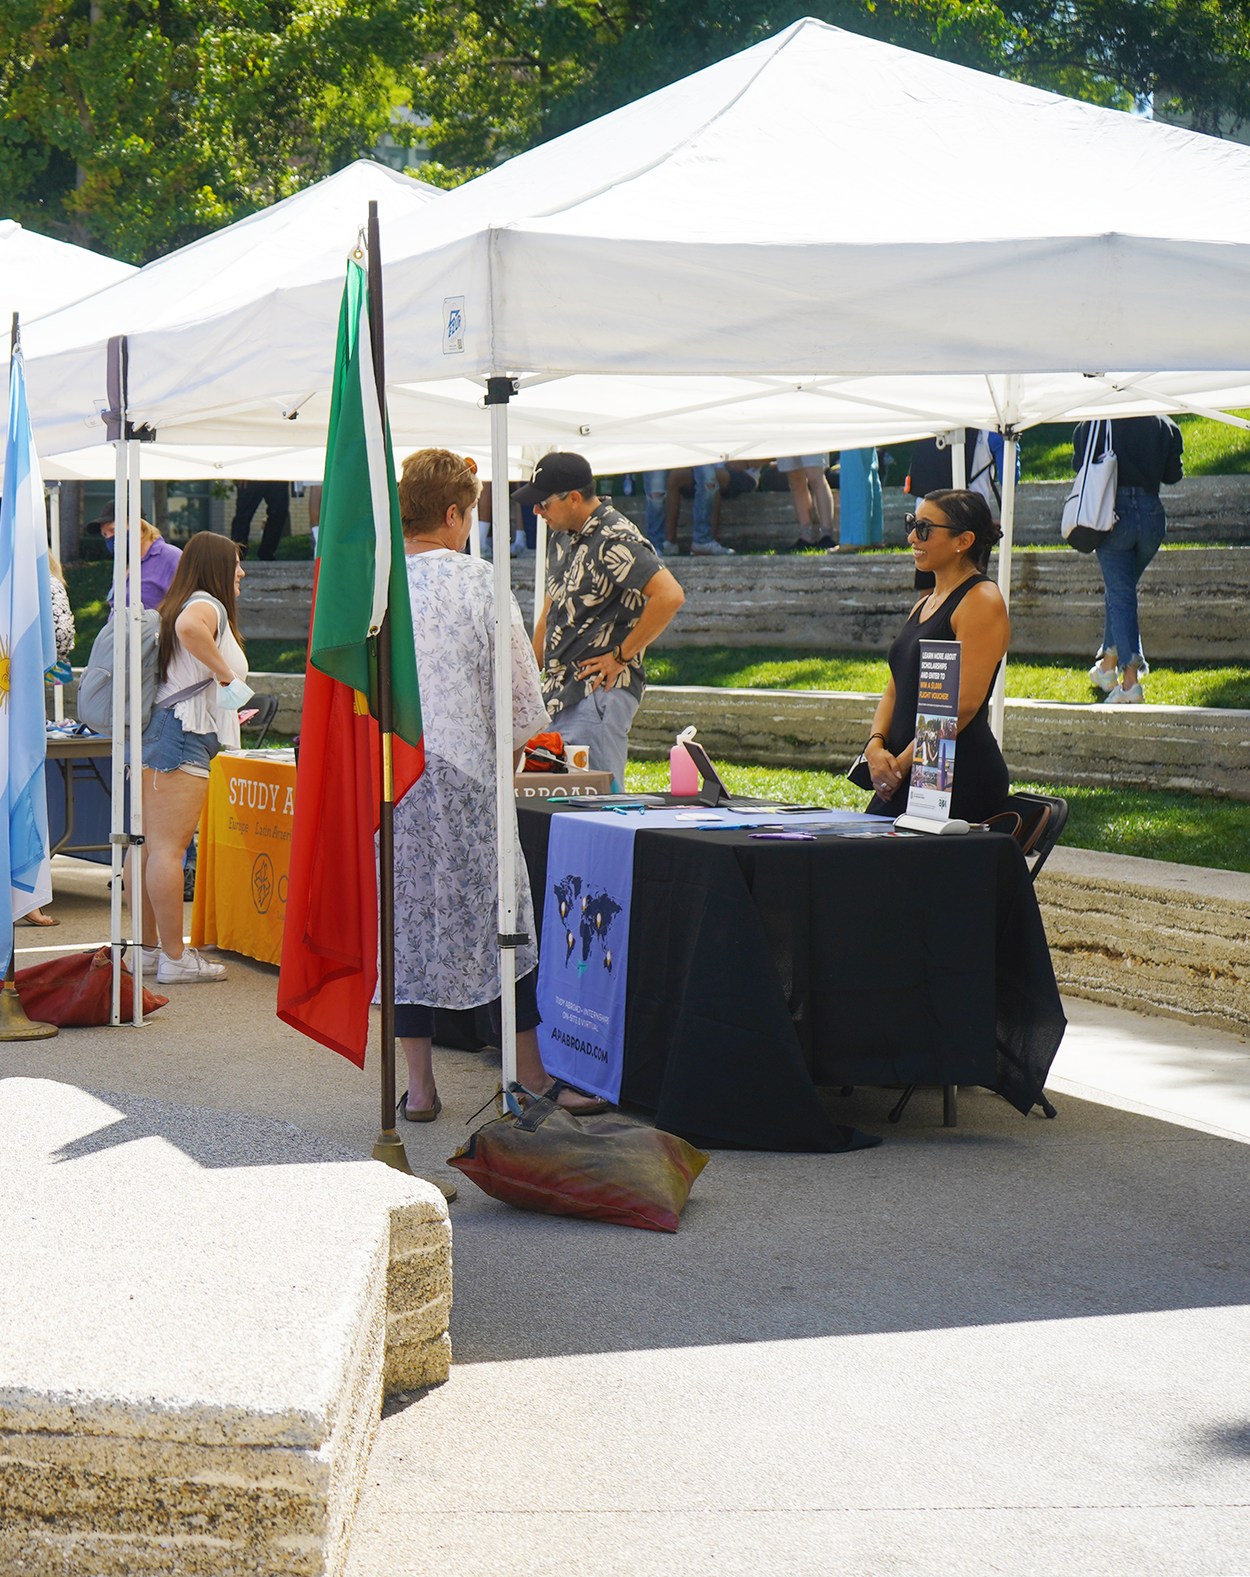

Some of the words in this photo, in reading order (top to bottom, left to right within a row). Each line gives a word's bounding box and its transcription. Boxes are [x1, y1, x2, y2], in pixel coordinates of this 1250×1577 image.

[920, 671, 928, 679] AND
[940, 672, 945, 680] TO
[229, 777, 280, 812] STUDY
[228, 816, 249, 835] Europe
[254, 821, 272, 838] Latin
